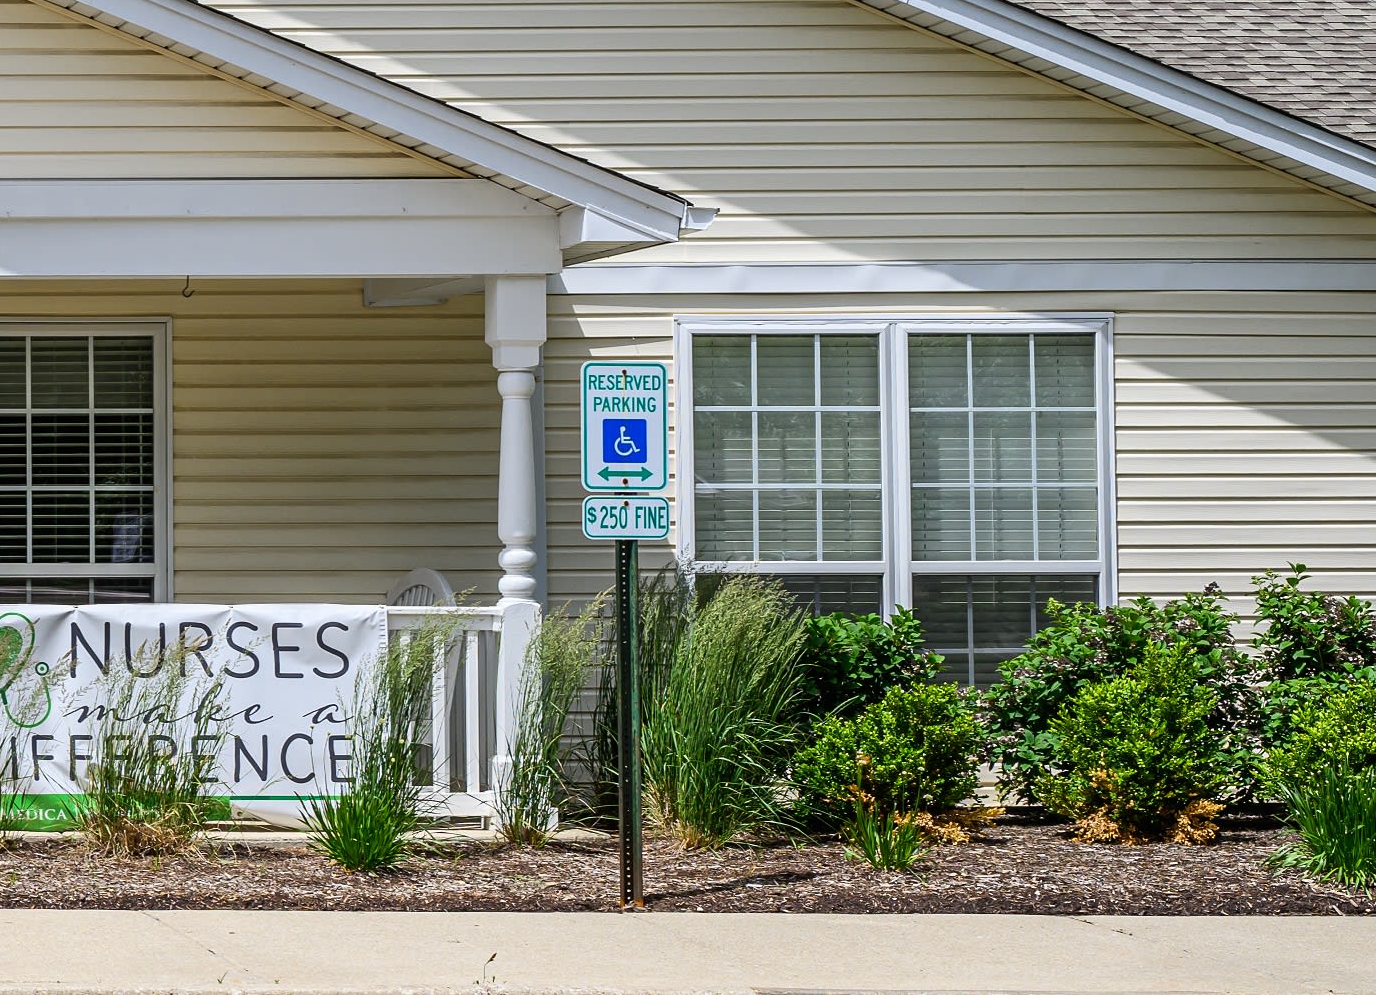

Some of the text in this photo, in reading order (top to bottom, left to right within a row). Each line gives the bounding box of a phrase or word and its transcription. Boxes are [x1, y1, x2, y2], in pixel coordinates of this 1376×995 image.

[588, 374, 662, 391] RESERVED
[593, 396, 657, 413] PARKING
[635, 506, 667, 529] FINE
[69, 621, 350, 679] NURSES
[62, 682, 355, 724] make a
